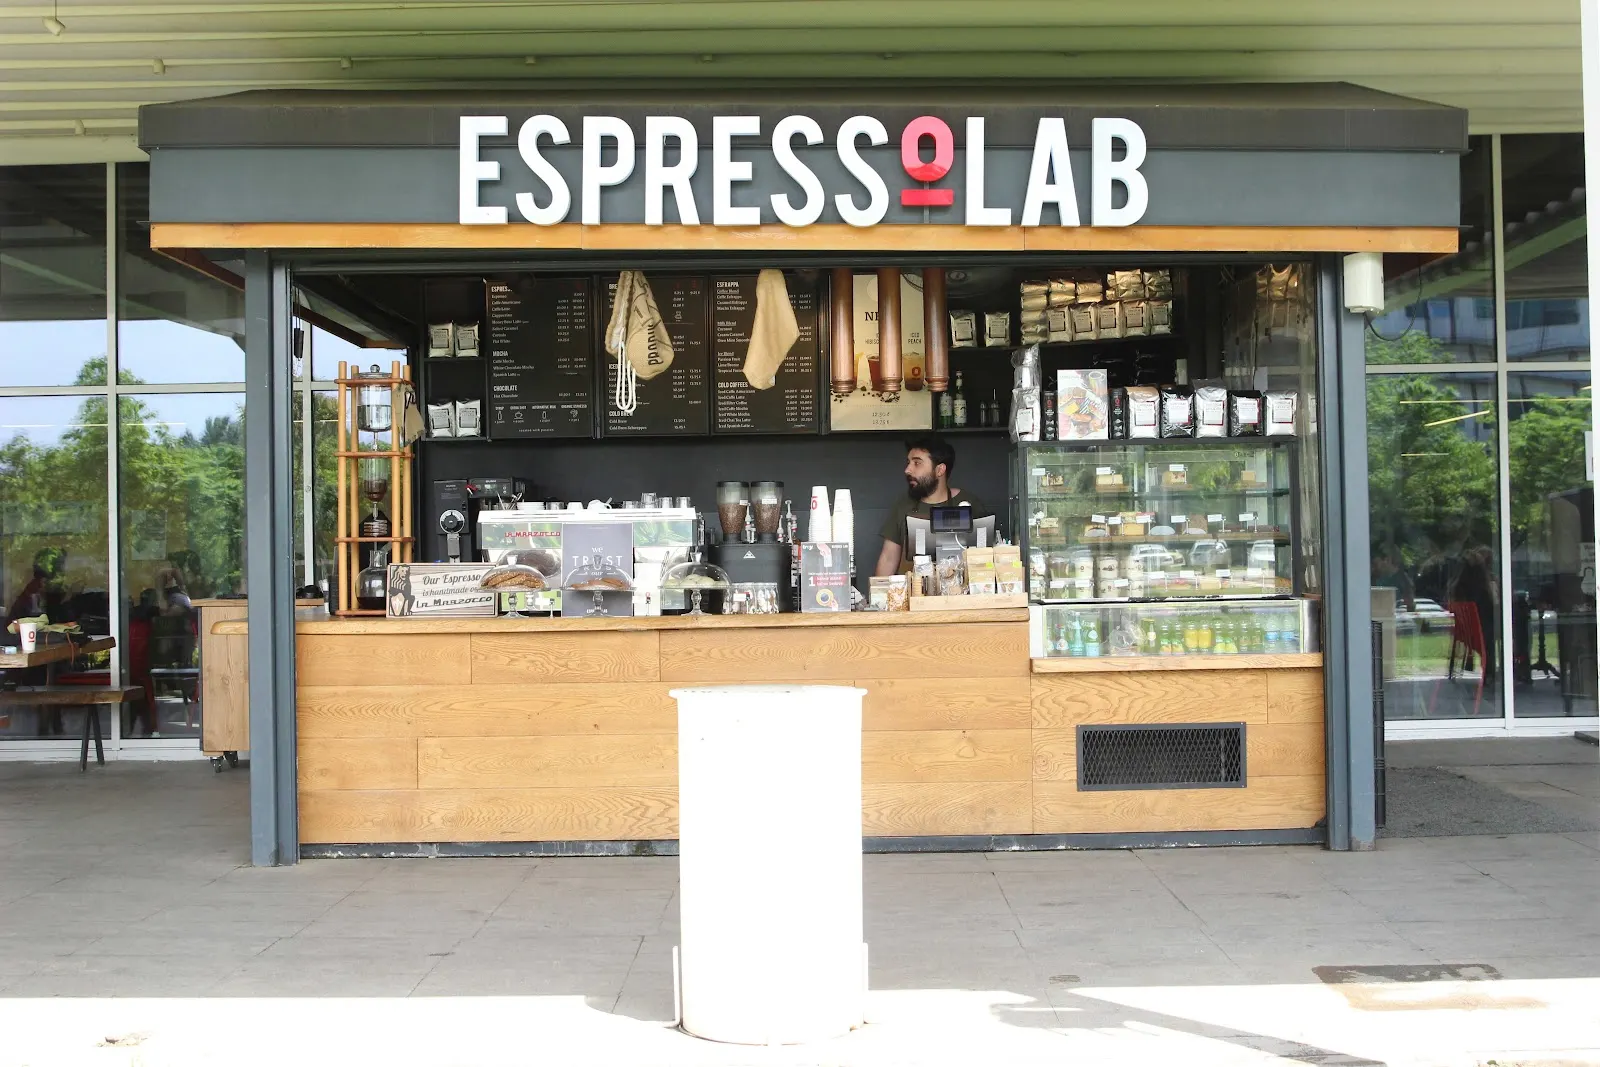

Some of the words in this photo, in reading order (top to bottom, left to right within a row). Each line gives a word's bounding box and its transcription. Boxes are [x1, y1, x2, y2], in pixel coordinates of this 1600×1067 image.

[459, 114, 1148, 227] ESPRESSOLAB
[572, 555, 622, 566] TRUST
[422, 576, 440, 585] Our
[443, 574, 480, 584] Espresso
[429, 587, 467, 596] handmade
